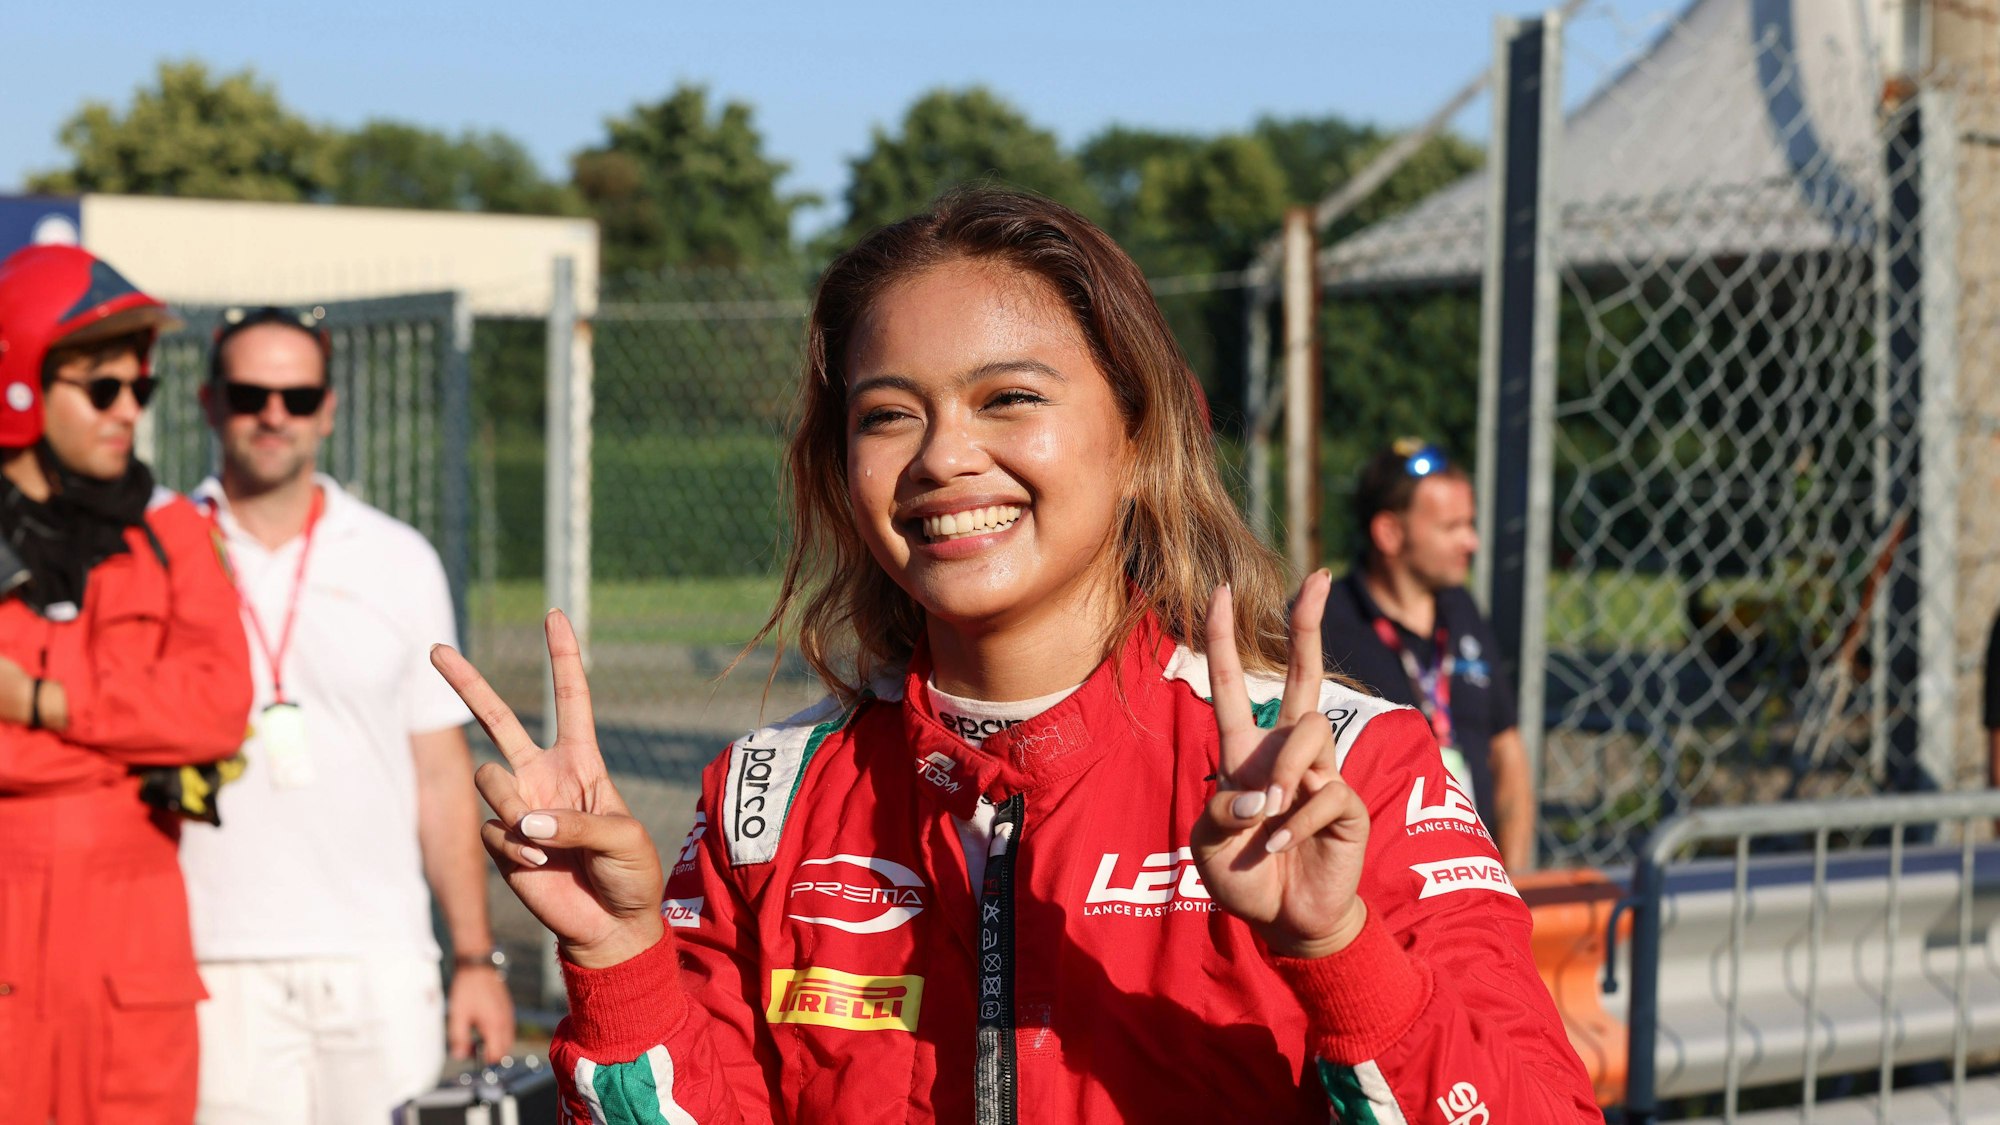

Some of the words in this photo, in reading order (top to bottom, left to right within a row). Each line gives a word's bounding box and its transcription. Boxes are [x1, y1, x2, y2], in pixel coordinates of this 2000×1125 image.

[939, 711, 1024, 739] spar
[740, 746, 777, 839] parco
[1406, 821, 1452, 836] LANCE
[1453, 821, 1475, 835] EAST
[790, 881, 923, 905] PREMA
[1084, 904, 1131, 916] LANCE
[1134, 906, 1169, 917] EAST
[1169, 900, 1222, 913] EXOTIC
[778, 978, 908, 1020] PIRELLI
